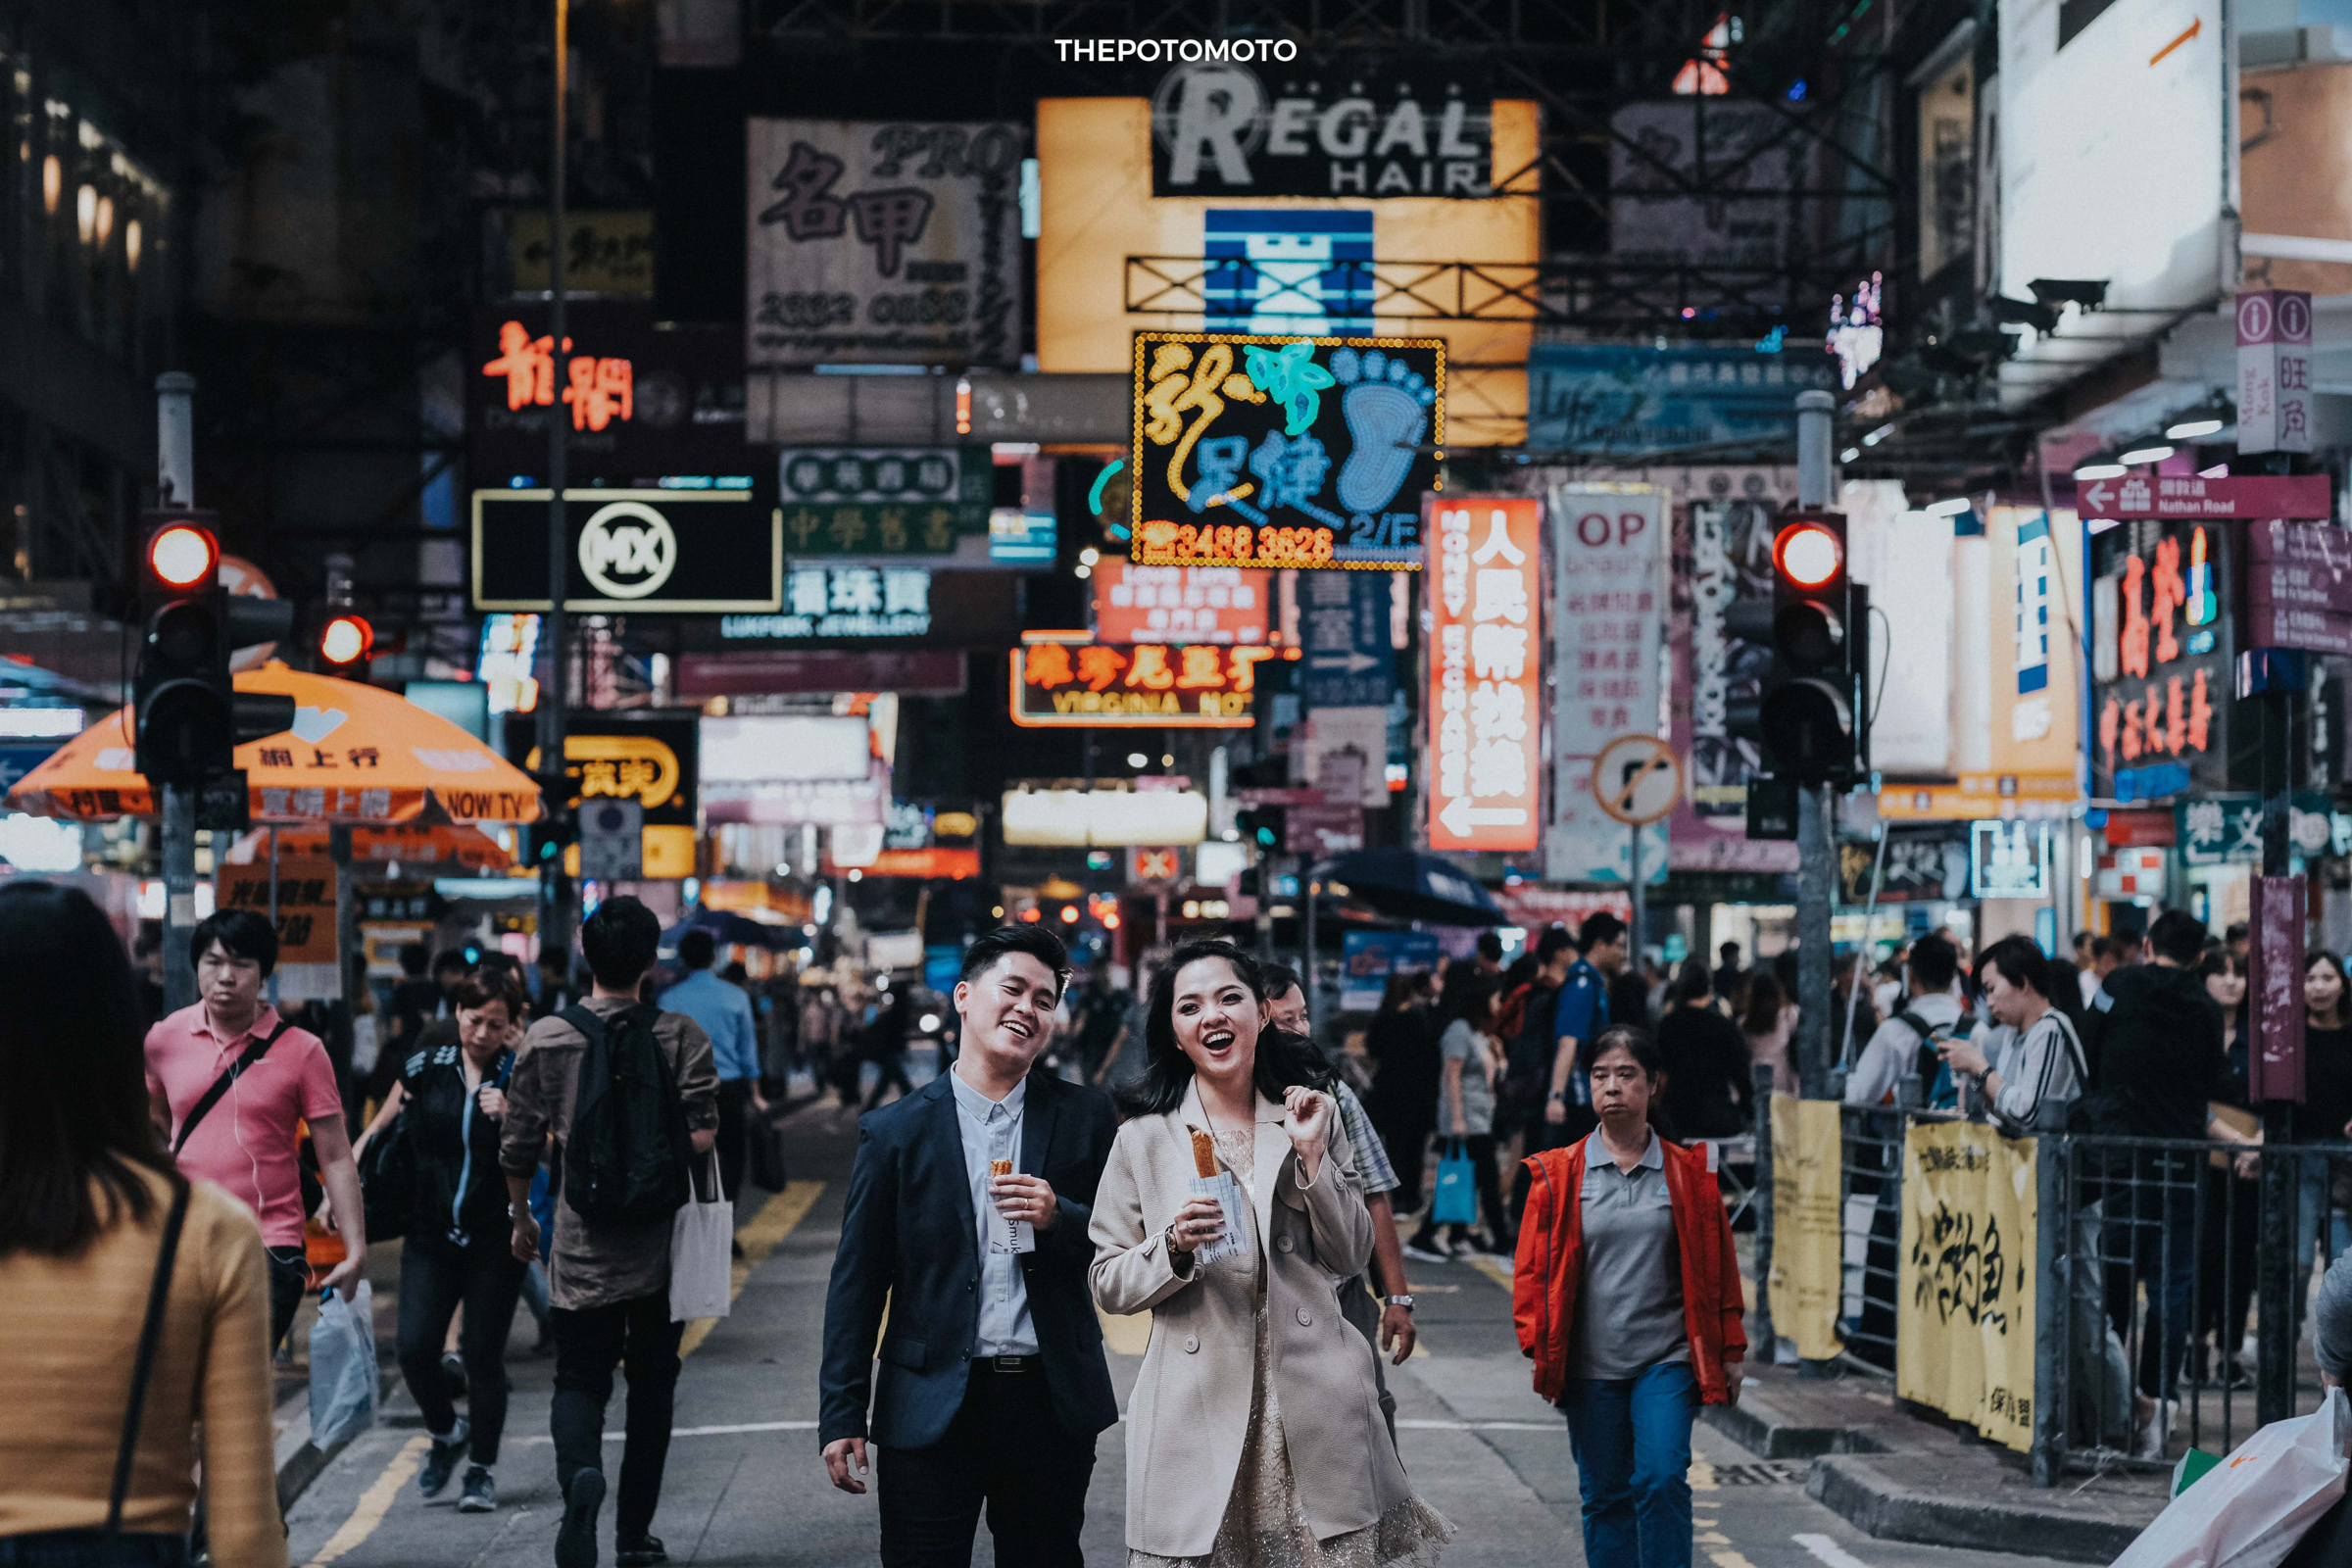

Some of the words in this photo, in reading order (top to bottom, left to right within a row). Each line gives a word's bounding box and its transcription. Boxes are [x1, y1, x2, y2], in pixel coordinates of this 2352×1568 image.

[1169, 71, 1481, 184] REGAL
[1330, 161, 1483, 193] HAIR
[760, 141, 935, 278] 名甲
[2243, 367, 2257, 425] Mong
[2258, 376, 2271, 418] Kok
[2281, 355, 2308, 442] 旺角
[2159, 499, 2200, 514] Nathan
[2204, 499, 2234, 514] Road
[1349, 512, 1419, 549] 2/F
[1577, 513, 1646, 547] OP
[1441, 510, 1470, 618] MONEY
[1053, 691, 1182, 716] VIRGINIA
[1439, 624, 1467, 798] EXCHANGE
[447, 791, 492, 819] NOW
